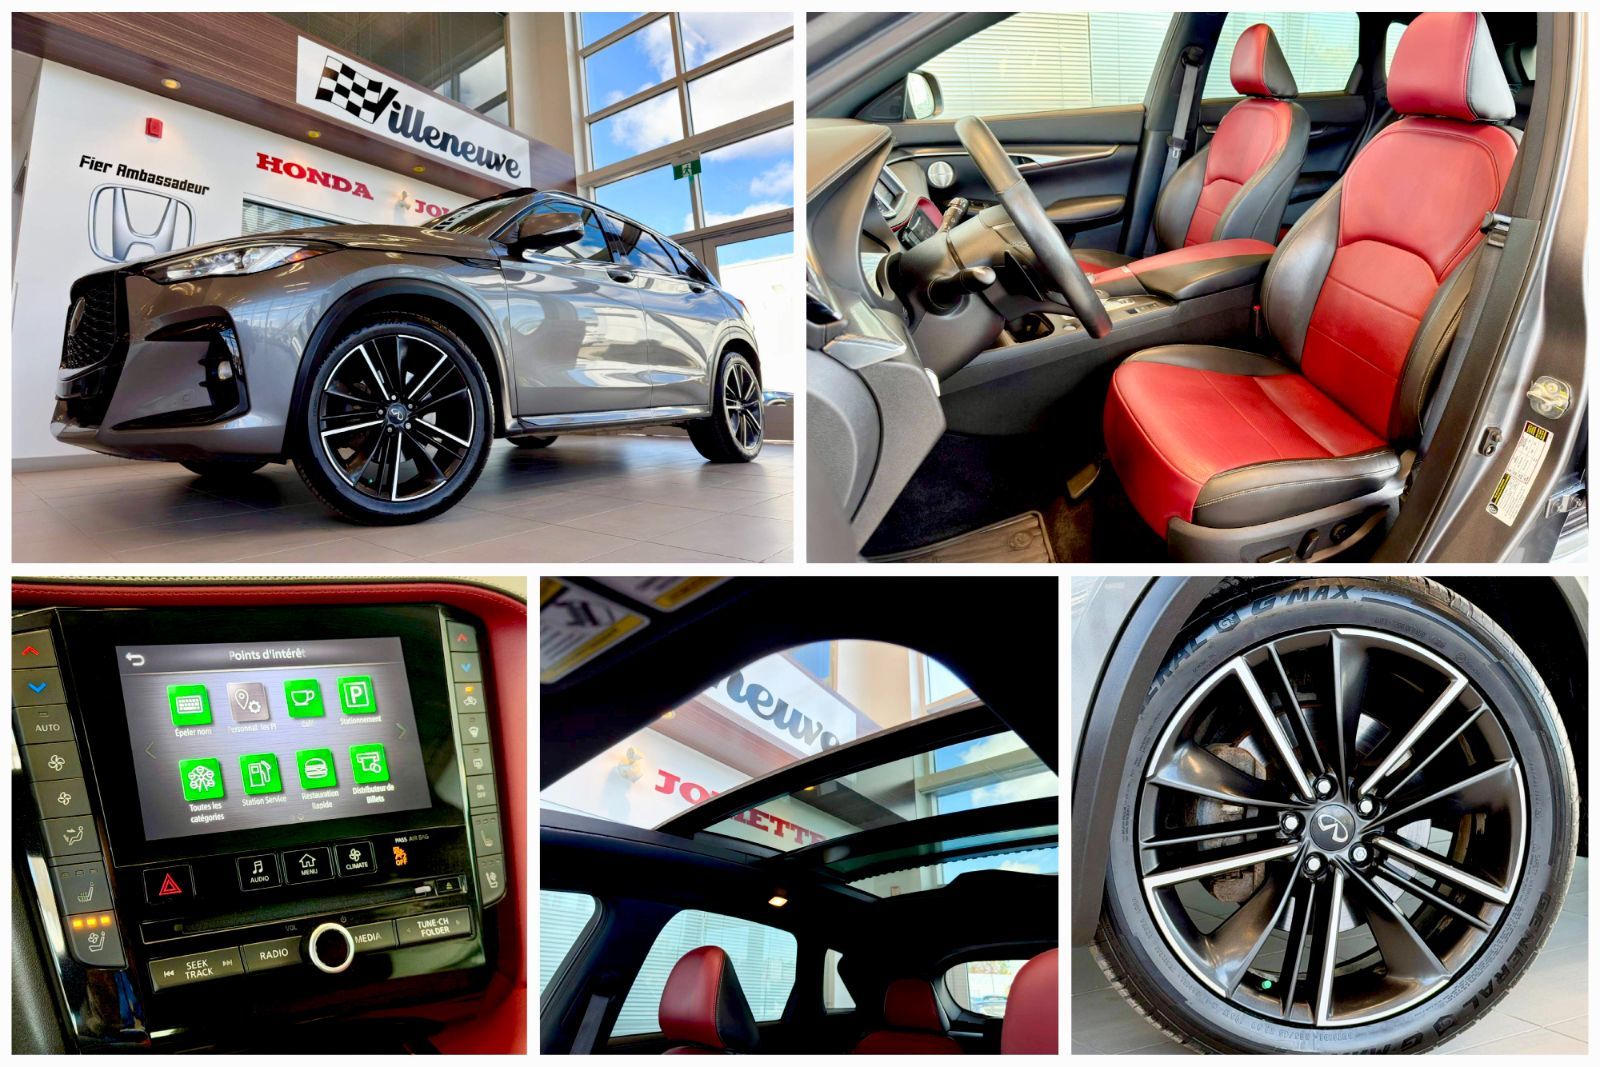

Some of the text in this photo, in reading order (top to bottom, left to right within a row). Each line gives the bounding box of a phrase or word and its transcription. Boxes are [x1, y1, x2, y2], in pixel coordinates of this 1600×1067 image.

[362, 86, 521, 179] Villeneuve
[79, 154, 210, 195] Fier Ambassadeur
[256, 152, 374, 200] HONDA
[415, 199, 449, 217] JO
[229, 647, 307, 661] Points d'intérêt
[35, 723, 61, 733] AUTO
[175, 727, 212, 737] Épeler nom
[352, 785, 386, 795] Distributeur
[189, 801, 222, 812] Toutes les
[241, 797, 265, 807] Station
[190, 812, 225, 824] catégories
[345, 861, 369, 870] CLIMATE
[301, 868, 319, 876] MENU
[250, 875, 270, 884] AUDIO
[421, 926, 450, 938] FOLDER
[354, 933, 382, 945] MEDIA
[259, 948, 289, 961] RADIO
[1463, 892, 1551, 1010] GENERAL
[186, 959, 209, 971] SEEK
[185, 967, 214, 981] TRACK
